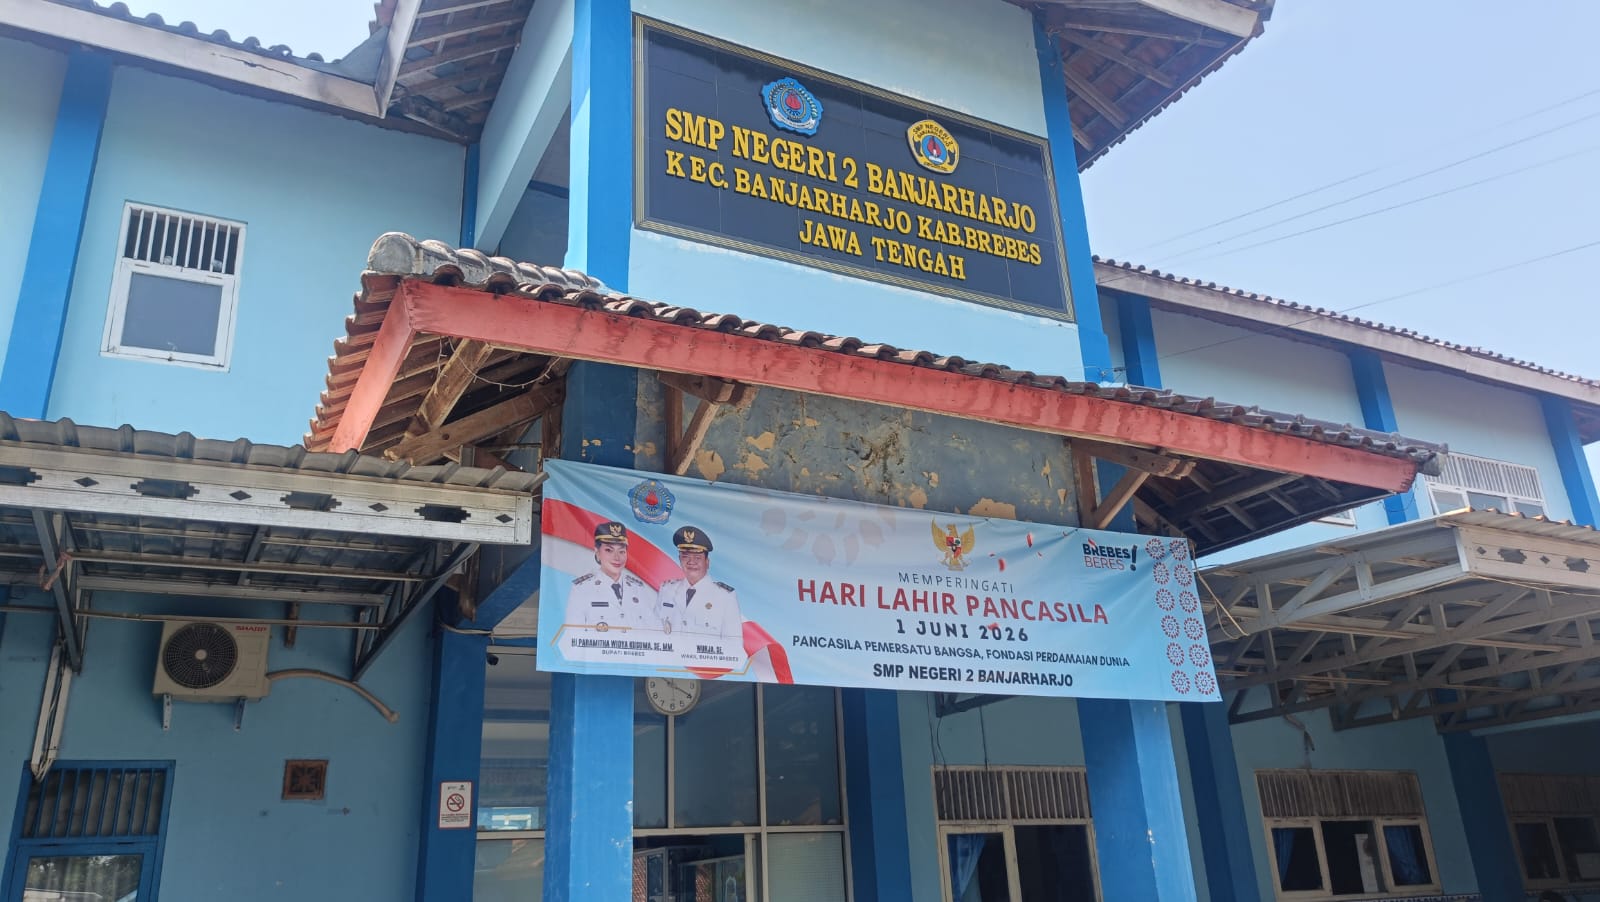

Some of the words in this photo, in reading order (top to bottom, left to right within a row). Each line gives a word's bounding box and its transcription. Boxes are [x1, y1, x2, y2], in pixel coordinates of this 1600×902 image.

[665, 107, 725, 151] SMP
[731, 125, 838, 182] NEGERI
[842, 157, 858, 189] 2
[865, 162, 1037, 234] BANJARHARJO
[665, 149, 729, 189] KEC.
[734, 167, 912, 234] BANJARHARJO
[799, 220, 863, 257] JAWA
[871, 235, 966, 280] TENGAH
[1082, 543, 1131, 559] BREBES
[1084, 556, 1125, 570] BERES
[898, 571, 1014, 593] MEMPERINGATI
[797, 578, 866, 608] HARI
[877, 586, 958, 616] LAHIR
[966, 595, 1109, 624] PANCASILA
[896, 619, 906, 634] 1
[916, 620, 969, 638] JUNI
[979, 624, 1029, 642] 2026
[792, 635, 862, 650] PANCASILA
[864, 640, 931, 656] PEMERSATU
[934, 645, 984, 661] BANGSA,
[986, 649, 1034, 662] FONDASI
[1036, 651, 1098, 666] PERDAMAIAN
[1099, 655, 1130, 667] DUNIA
[873, 663, 904, 678] SMP
[909, 664, 962, 681] NEGERI
[966, 669, 974, 682] 2
[978, 669, 1073, 687] BANJARHARJO
